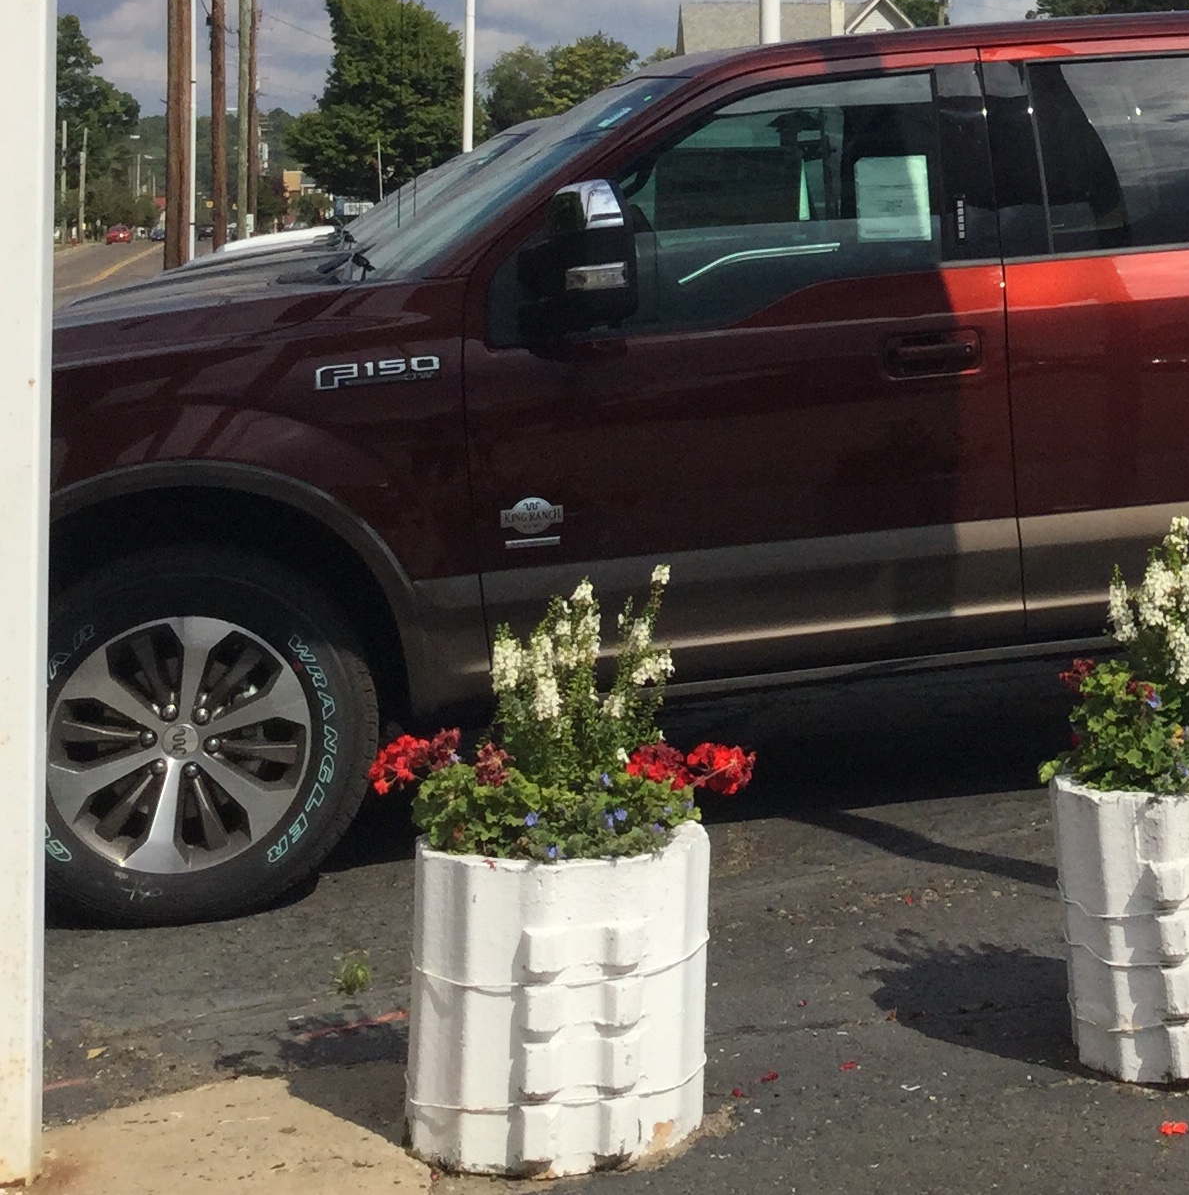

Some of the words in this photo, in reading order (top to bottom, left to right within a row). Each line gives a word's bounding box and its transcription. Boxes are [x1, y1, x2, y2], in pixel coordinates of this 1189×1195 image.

[504, 512, 527, 524] KING
[529, 508, 561, 522] RANCH
[267, 634, 338, 863] WRANGLER
